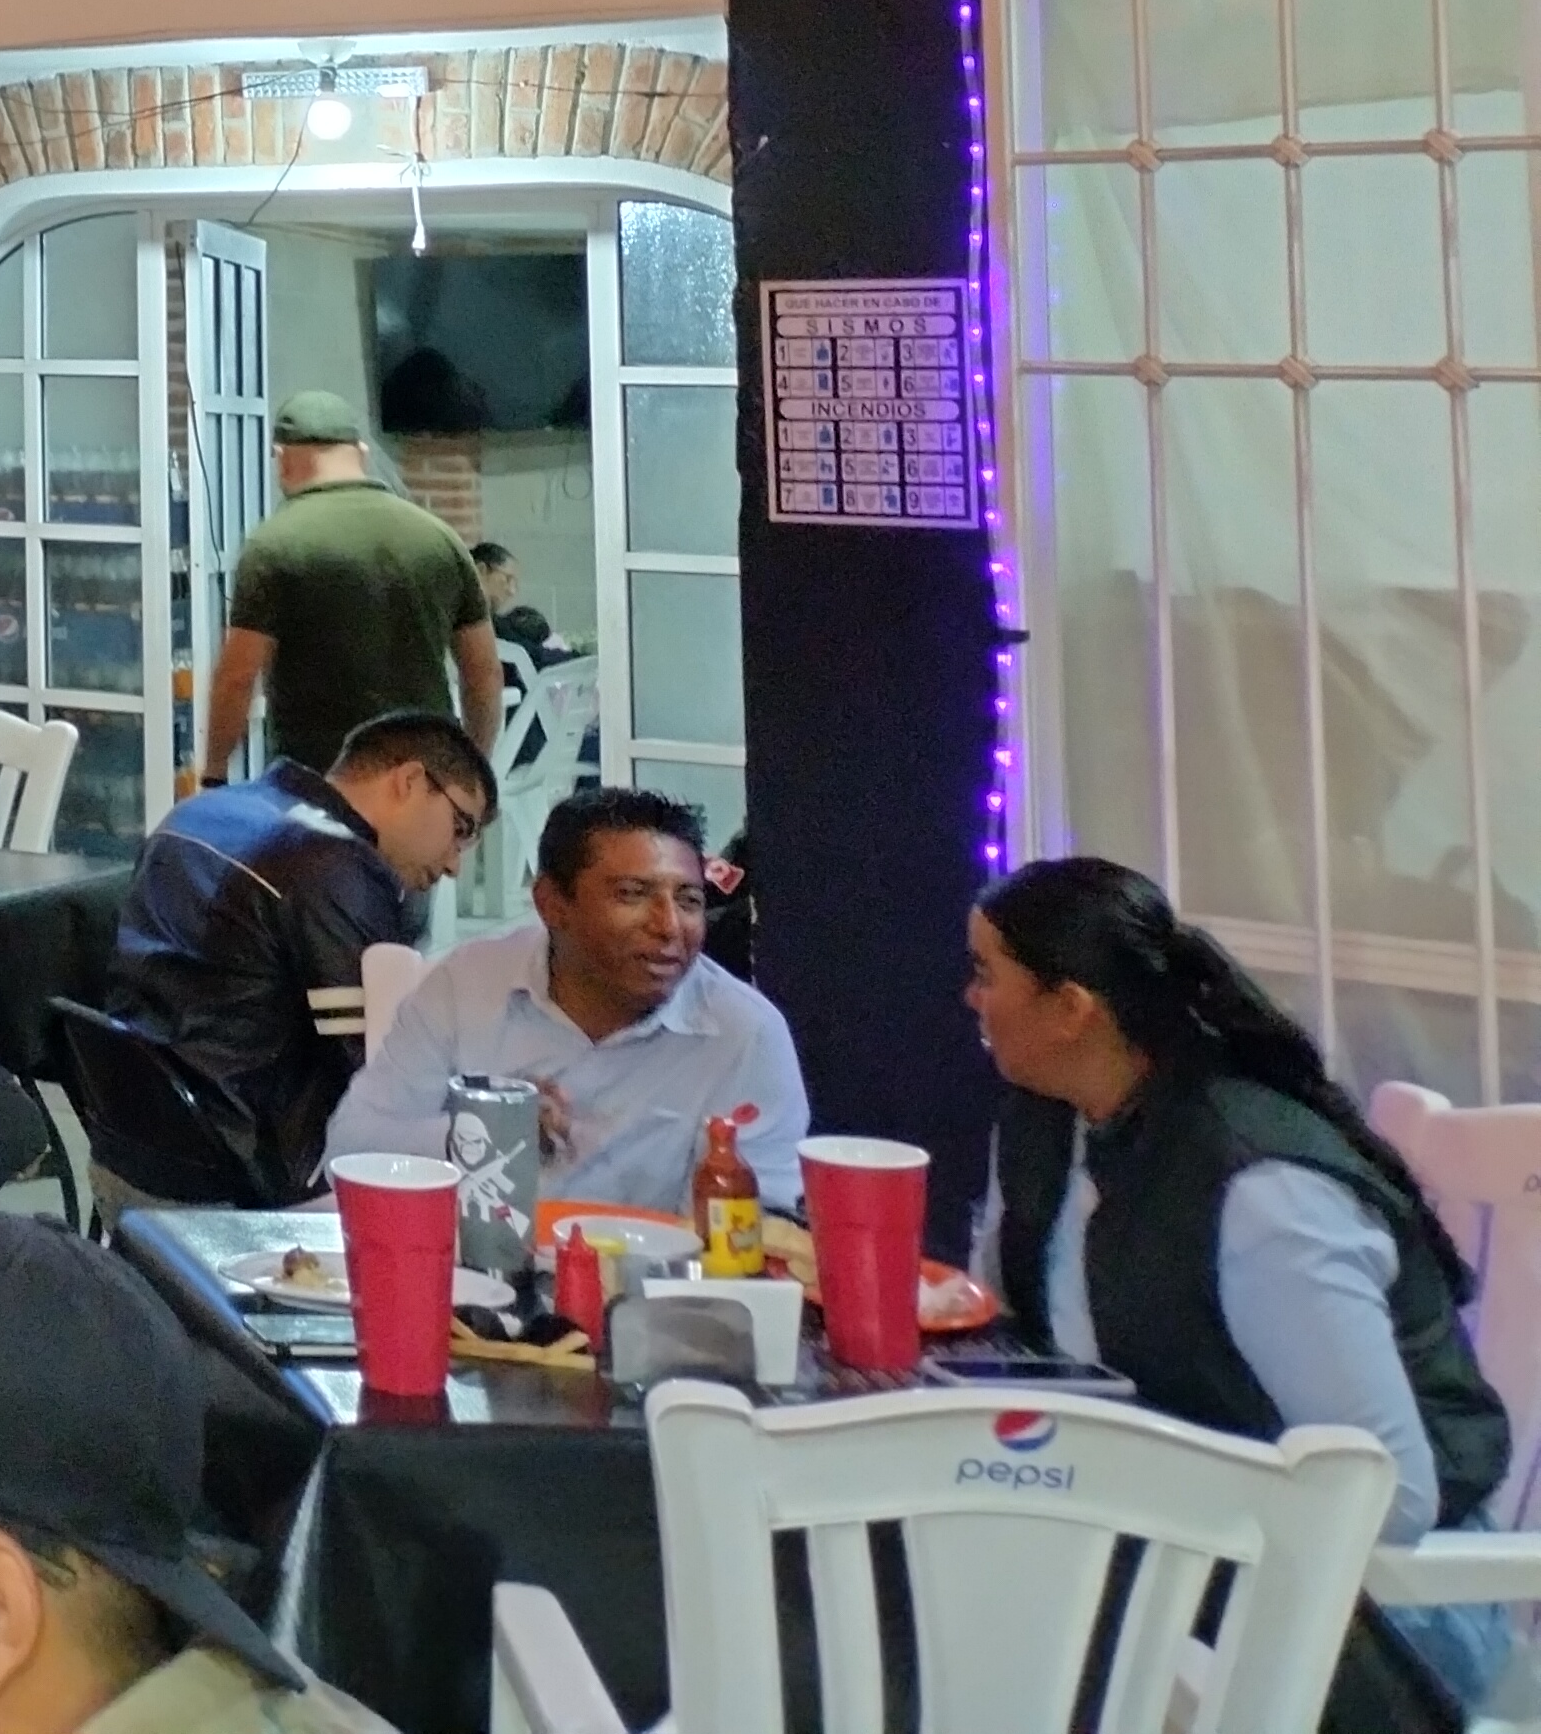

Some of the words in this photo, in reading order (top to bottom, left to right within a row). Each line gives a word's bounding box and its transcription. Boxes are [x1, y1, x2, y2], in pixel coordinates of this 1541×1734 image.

[815, 296, 859, 309] HACER
[863, 296, 880, 308] EN
[811, 400, 927, 417] INCENDIOS
[955, 1458, 1074, 1490] pepsi
